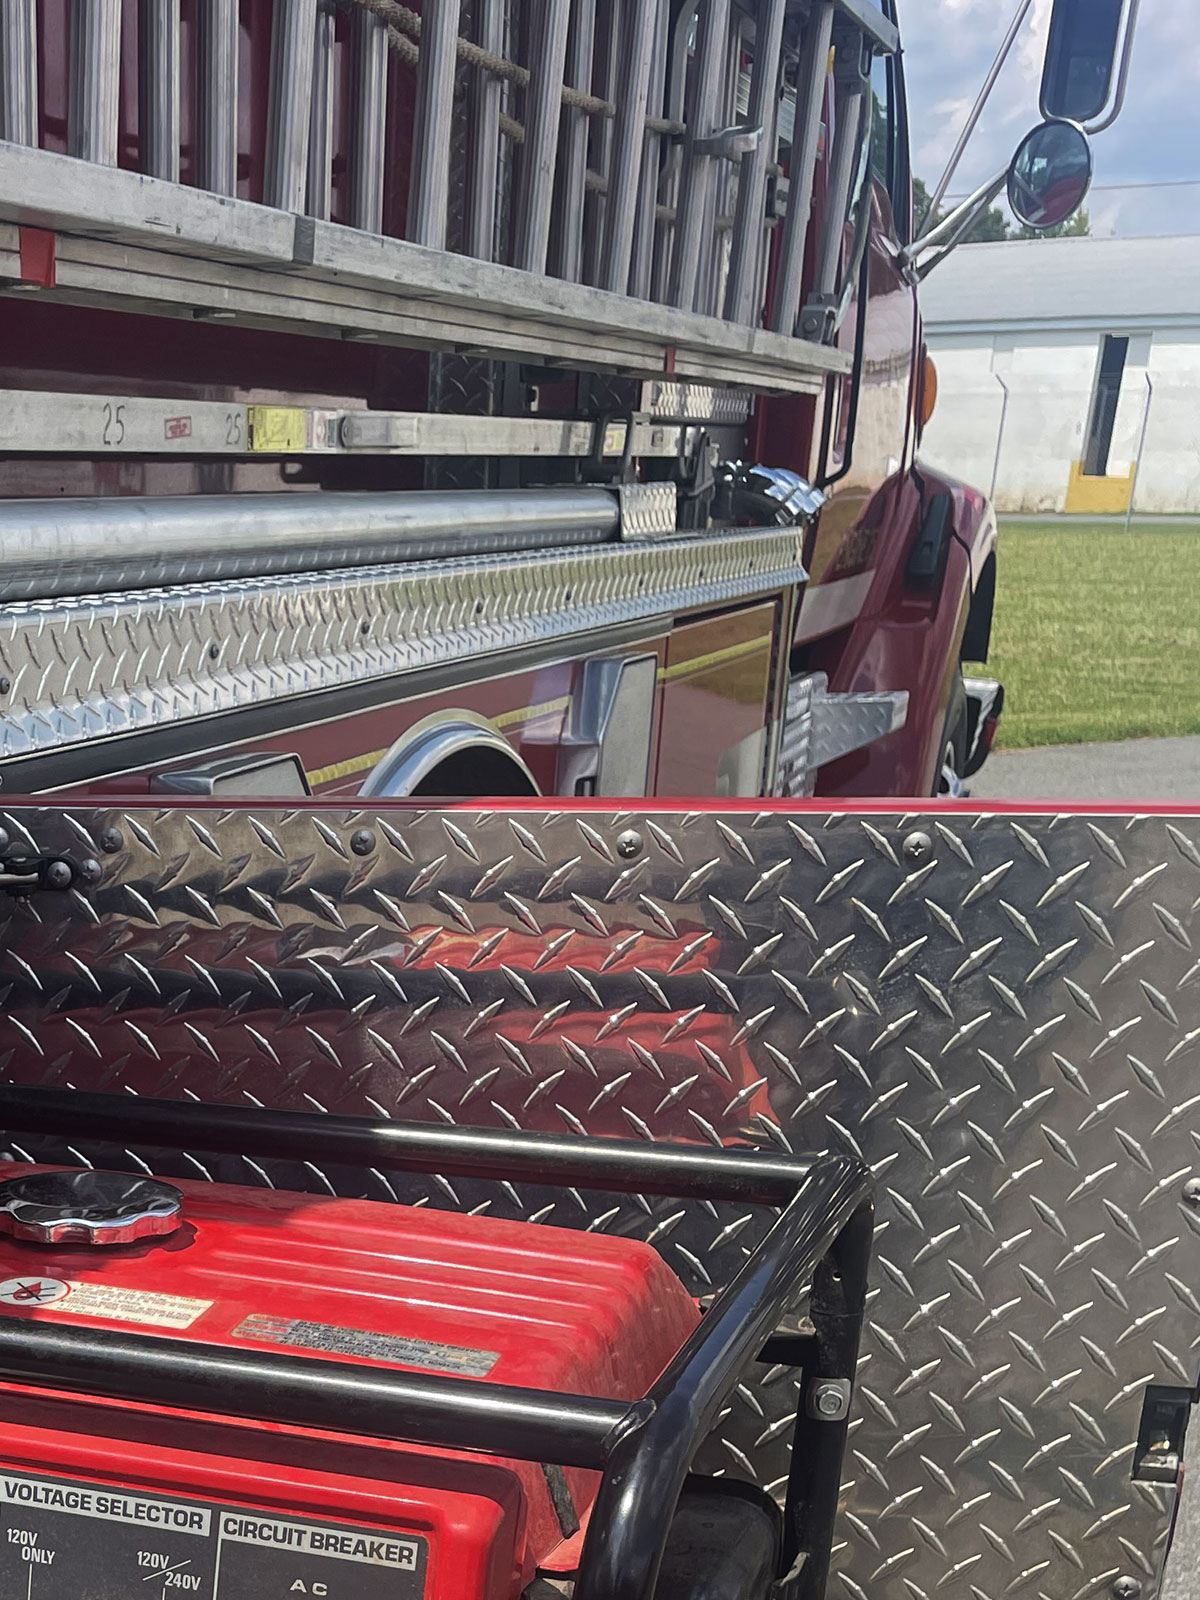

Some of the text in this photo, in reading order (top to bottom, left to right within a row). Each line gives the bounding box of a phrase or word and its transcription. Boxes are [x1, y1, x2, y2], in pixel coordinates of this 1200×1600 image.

[102, 402, 126, 446] 25
[225, 412, 241, 446] 25
[4, 1481, 204, 1531] VOLTAGE SELECTOR
[6, 1528, 38, 1547] 120V
[223, 1517, 413, 1565] CIRCUIT BREAKER
[21, 1546, 55, 1565] ONLY
[136, 1550, 170, 1570] 120V
[164, 1571, 202, 1591] 240V
